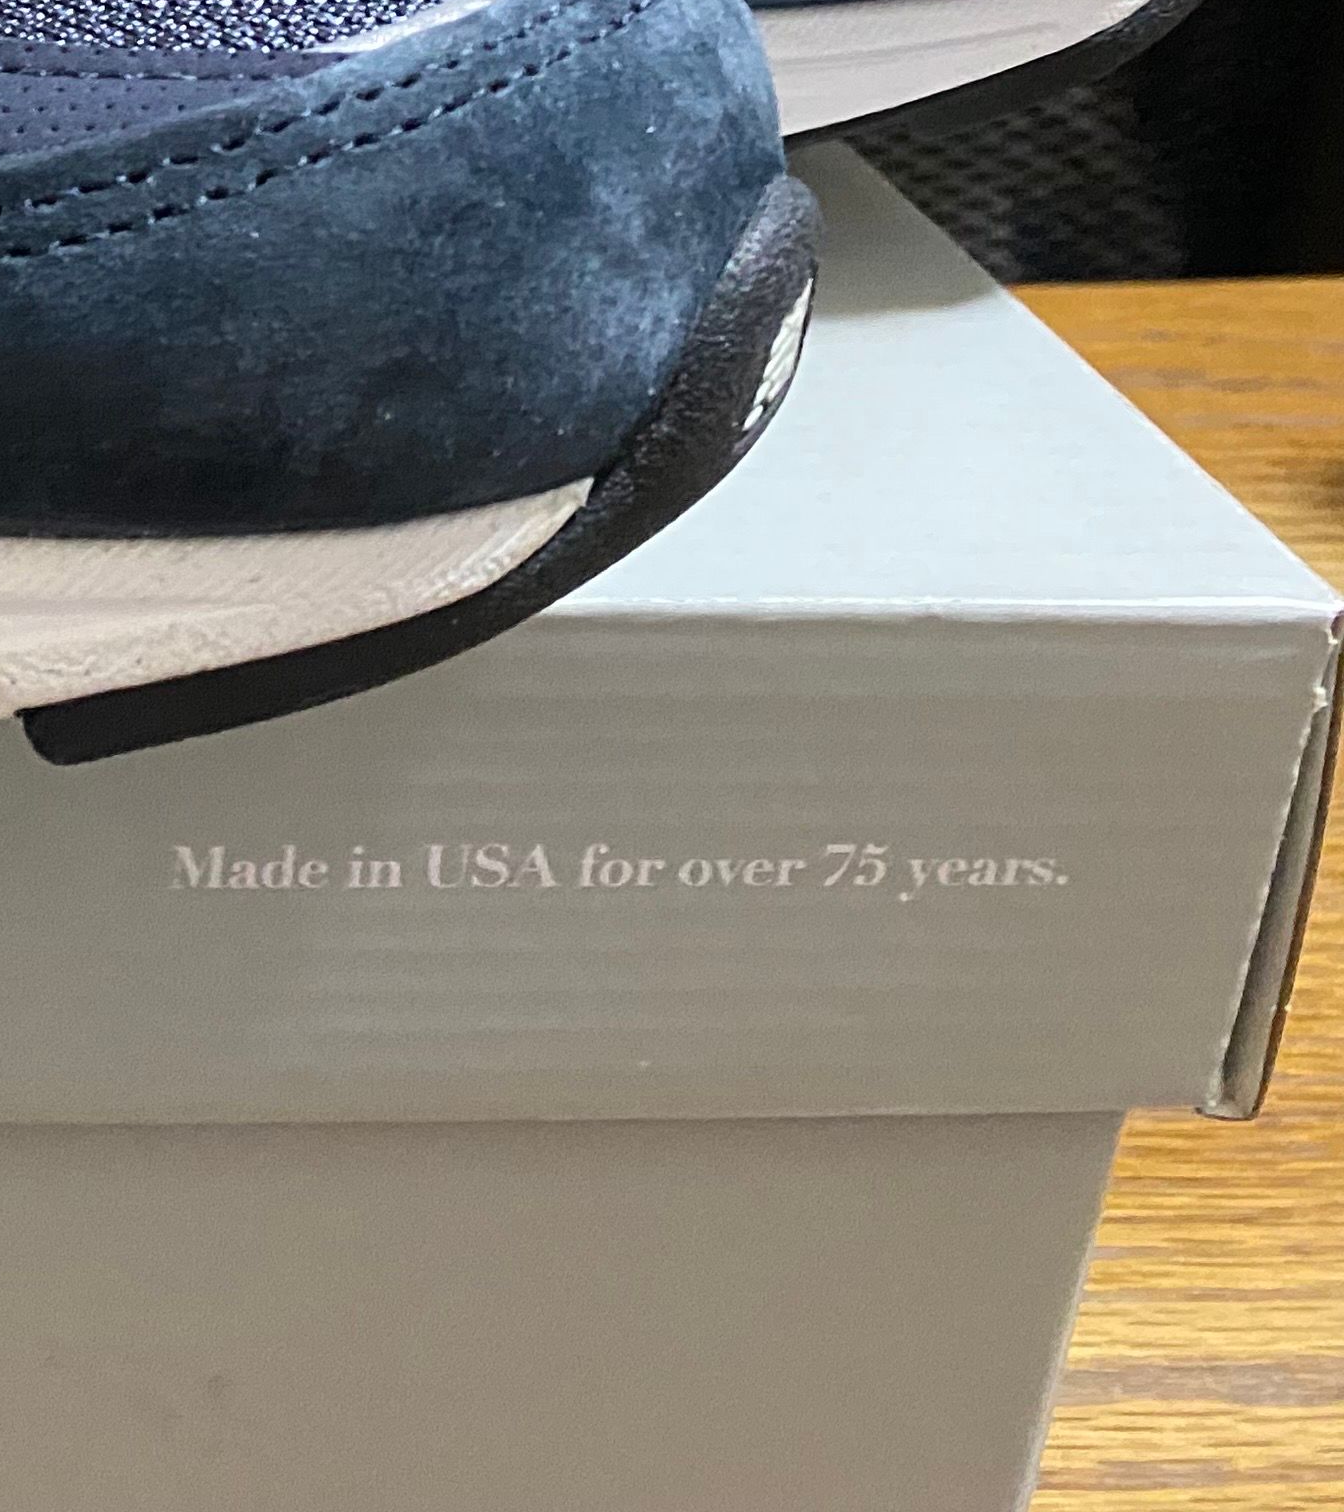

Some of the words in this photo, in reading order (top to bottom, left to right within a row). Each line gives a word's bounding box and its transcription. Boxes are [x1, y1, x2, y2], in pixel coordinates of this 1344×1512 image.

[172, 845, 328, 888] Made
[347, 845, 401, 888] in
[427, 844, 557, 888] USA
[579, 844, 665, 887] for
[678, 859, 806, 886] over
[823, 843, 890, 887] 75
[899, 858, 1069, 902] years.
